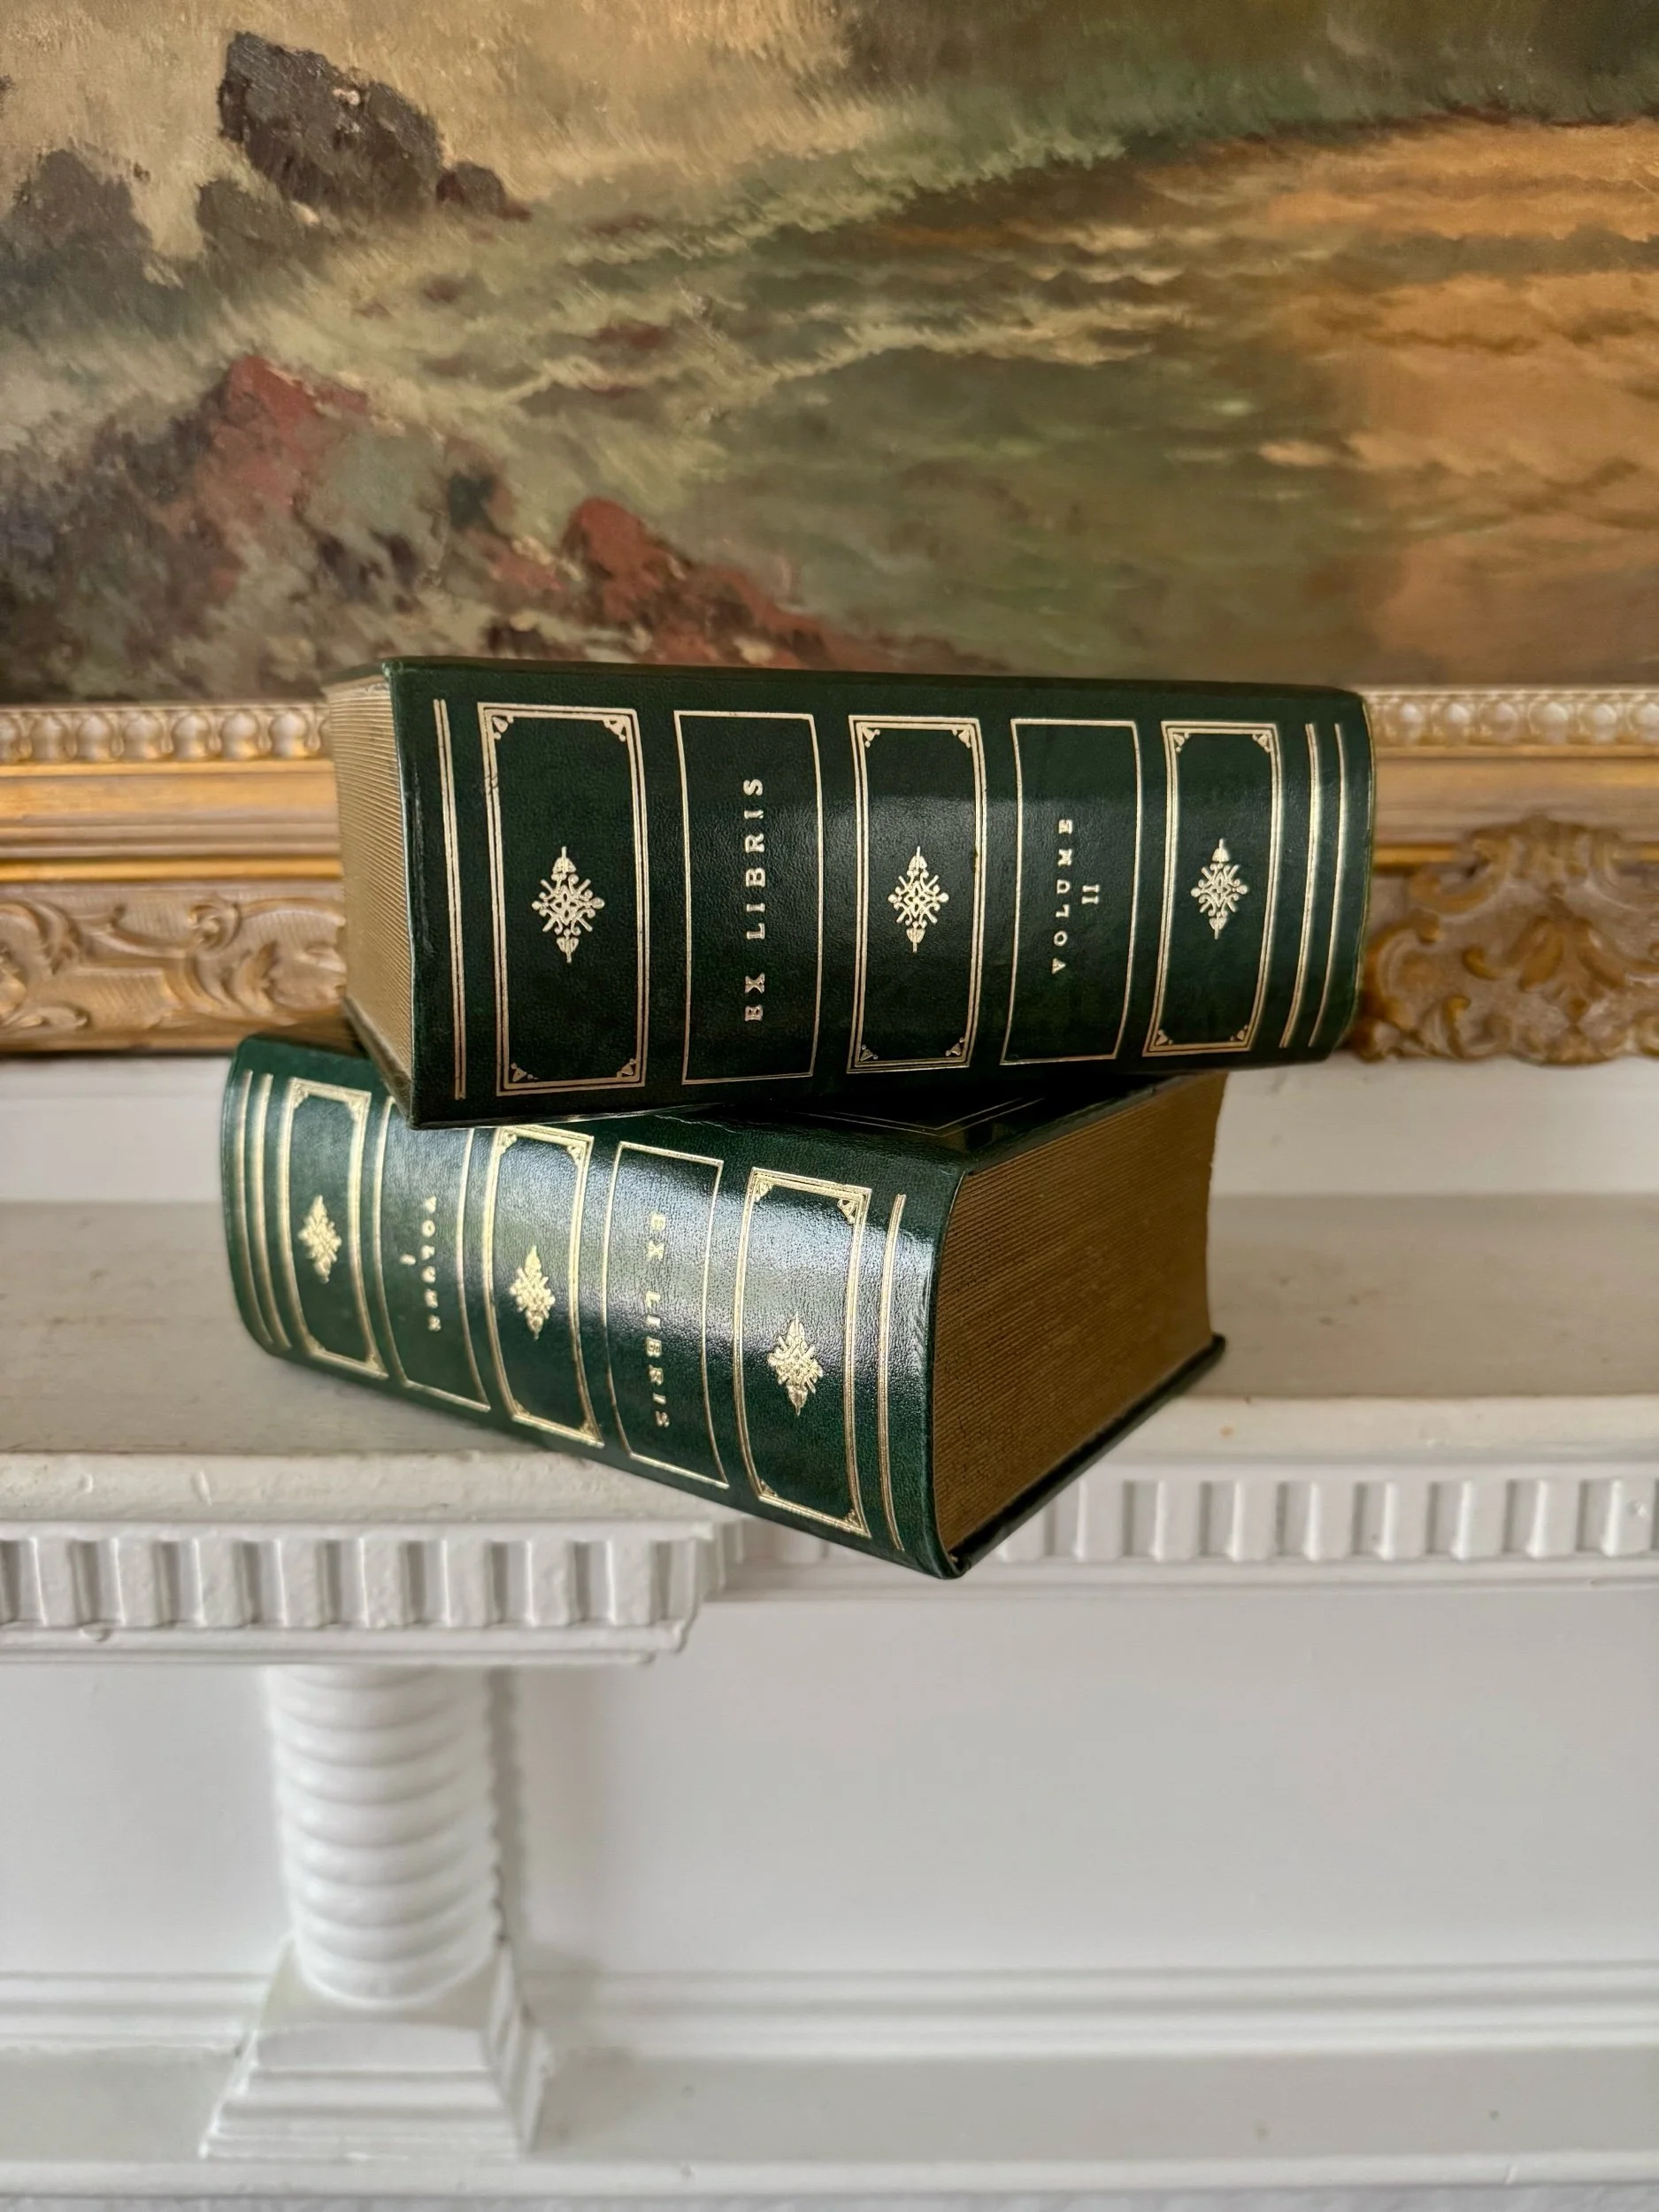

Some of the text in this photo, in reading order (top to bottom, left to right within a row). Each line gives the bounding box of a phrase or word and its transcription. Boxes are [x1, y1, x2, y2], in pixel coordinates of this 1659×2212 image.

[742, 779, 766, 1022] EX LIBRIS
[1051, 818, 1073, 974] VOLUME
[1080, 884, 1101, 905] II
[420, 1195, 442, 1333] VOLUME
[644, 1212, 670, 1428] EX LIBRIS
